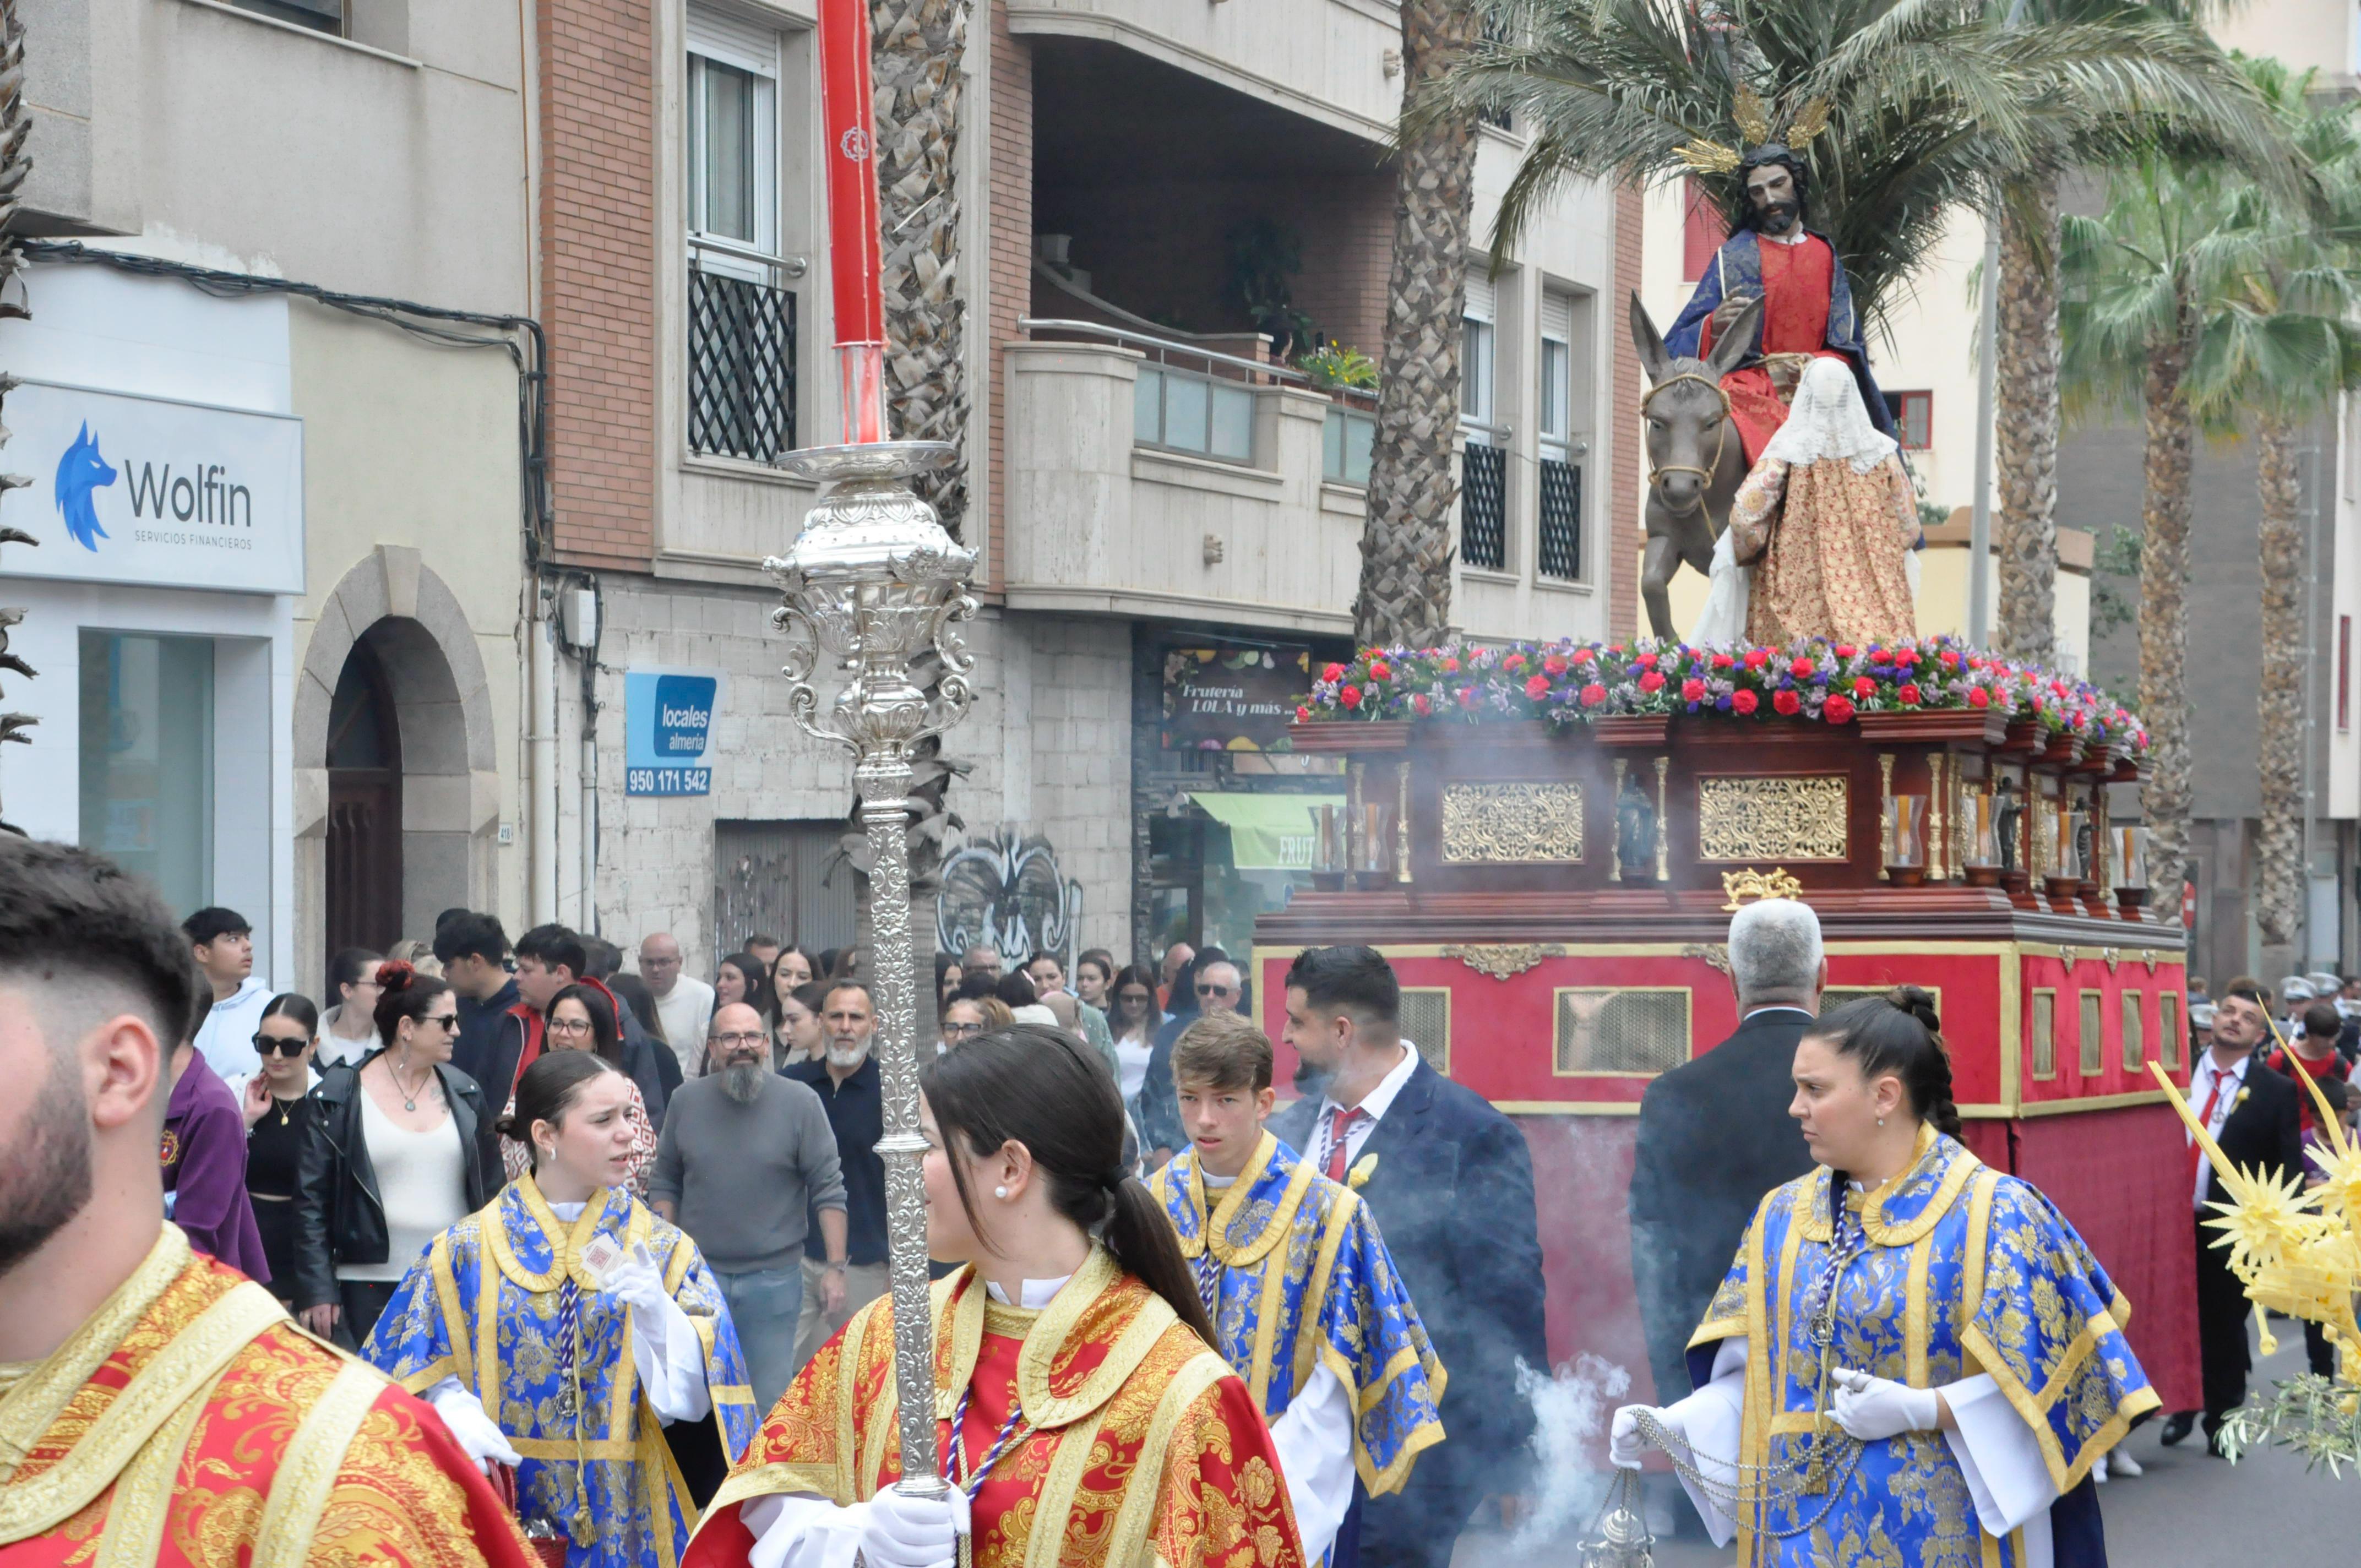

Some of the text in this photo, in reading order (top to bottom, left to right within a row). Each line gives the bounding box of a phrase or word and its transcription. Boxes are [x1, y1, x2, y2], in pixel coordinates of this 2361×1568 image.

[124, 459, 251, 527] Wolfin
[135, 530, 252, 551] SERVICIOS FINANCIEROS
[1183, 684, 1244, 699] Frutería
[662, 703, 709, 728] locales
[1192, 699, 1233, 714] LOLA
[1236, 703, 1247, 716] y
[1249, 699, 1282, 715] más
[629, 769, 708, 792] 950 171 542
